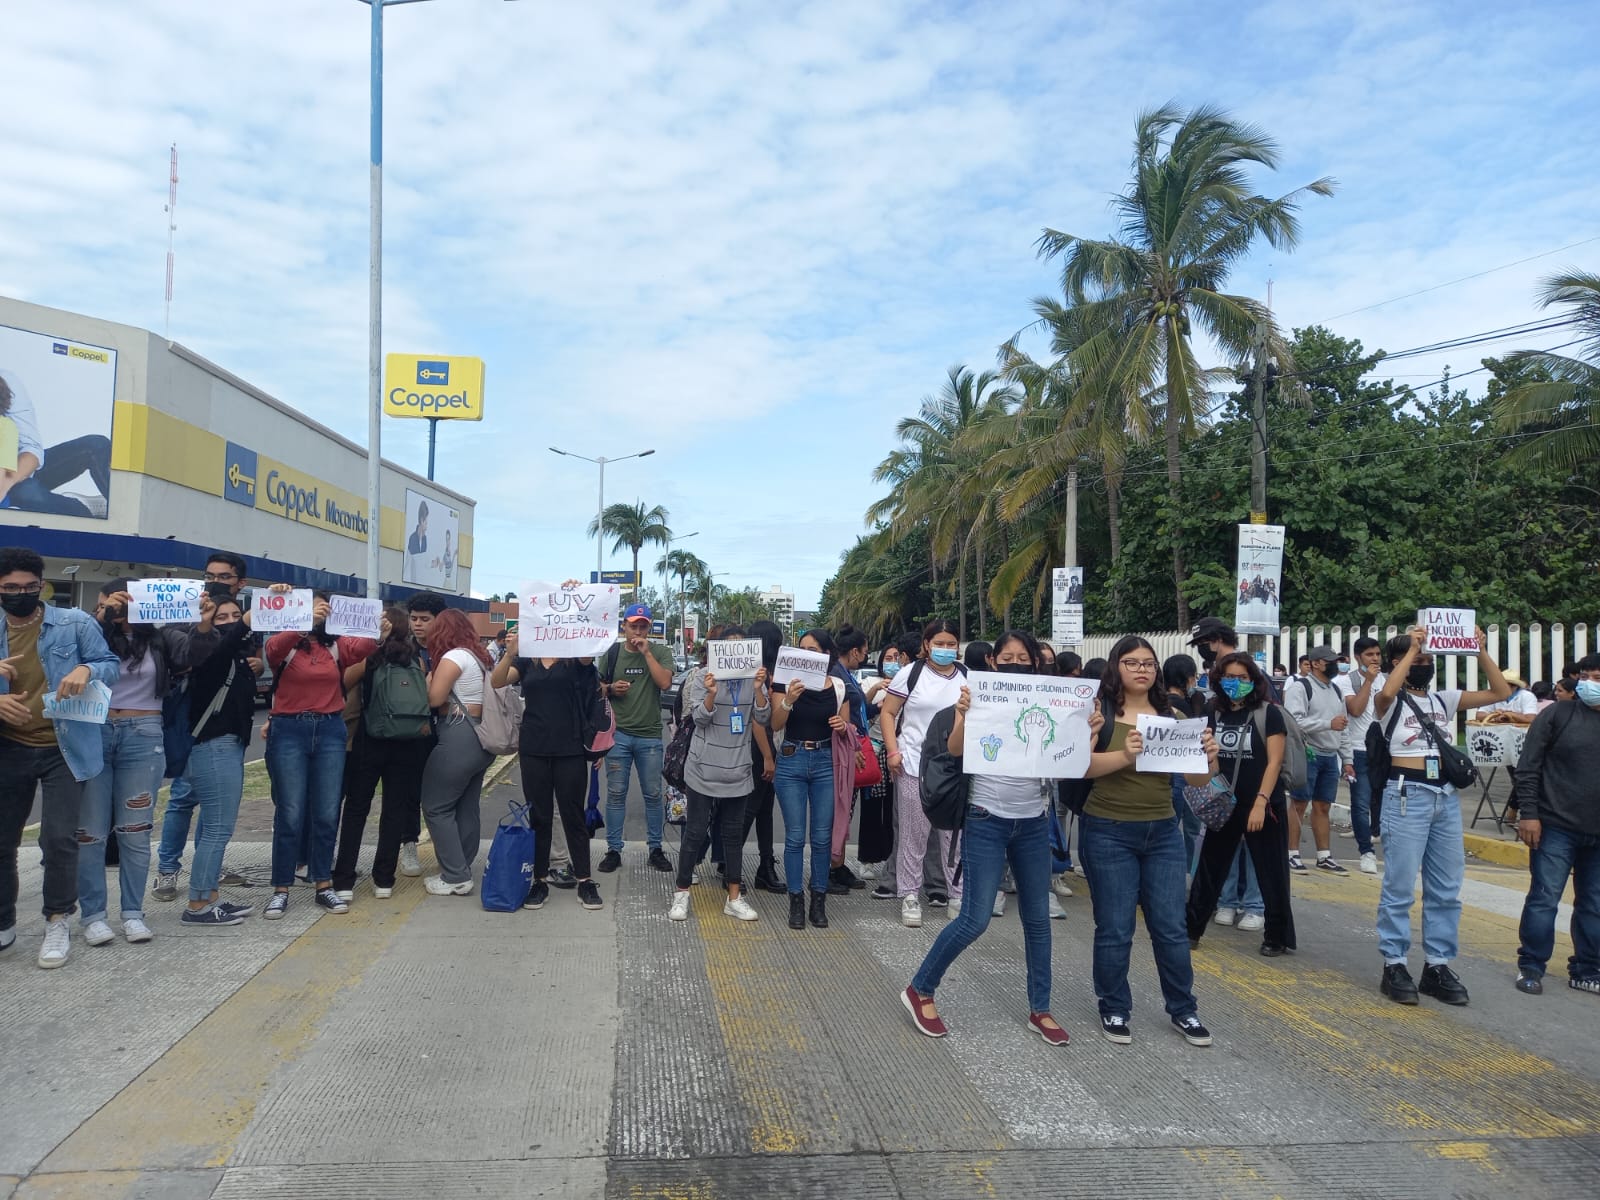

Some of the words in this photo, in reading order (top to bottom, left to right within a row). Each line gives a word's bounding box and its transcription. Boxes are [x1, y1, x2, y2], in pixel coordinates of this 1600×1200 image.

[71, 348, 105, 362] Coppel
[389, 387, 471, 412] Coppel
[266, 470, 320, 520] Coppel
[147, 583, 181, 592] FACON
[156, 593, 174, 602] NO
[260, 596, 285, 610] NO
[548, 592, 596, 612] UV
[139, 609, 193, 620] VIOLENCIA
[543, 614, 591, 626] TOLERA
[1429, 611, 1443, 624] LA
[1446, 612, 1461, 625] UV
[534, 625, 609, 642] INTOLERANCIA
[747, 642, 760, 656] NO
[1429, 636, 1478, 650] ACOSADORES
[717, 657, 757, 670] ENCUBRE
[978, 681, 988, 690] LA
[992, 681, 1032, 692] COMUNIDAD
[1077, 687, 1091, 696] NO
[978, 694, 1009, 703] TOLERA
[1049, 698, 1085, 708] VIOLENCIA
[1146, 726, 1169, 741] UV
[1143, 744, 1203, 758] Acosadores
